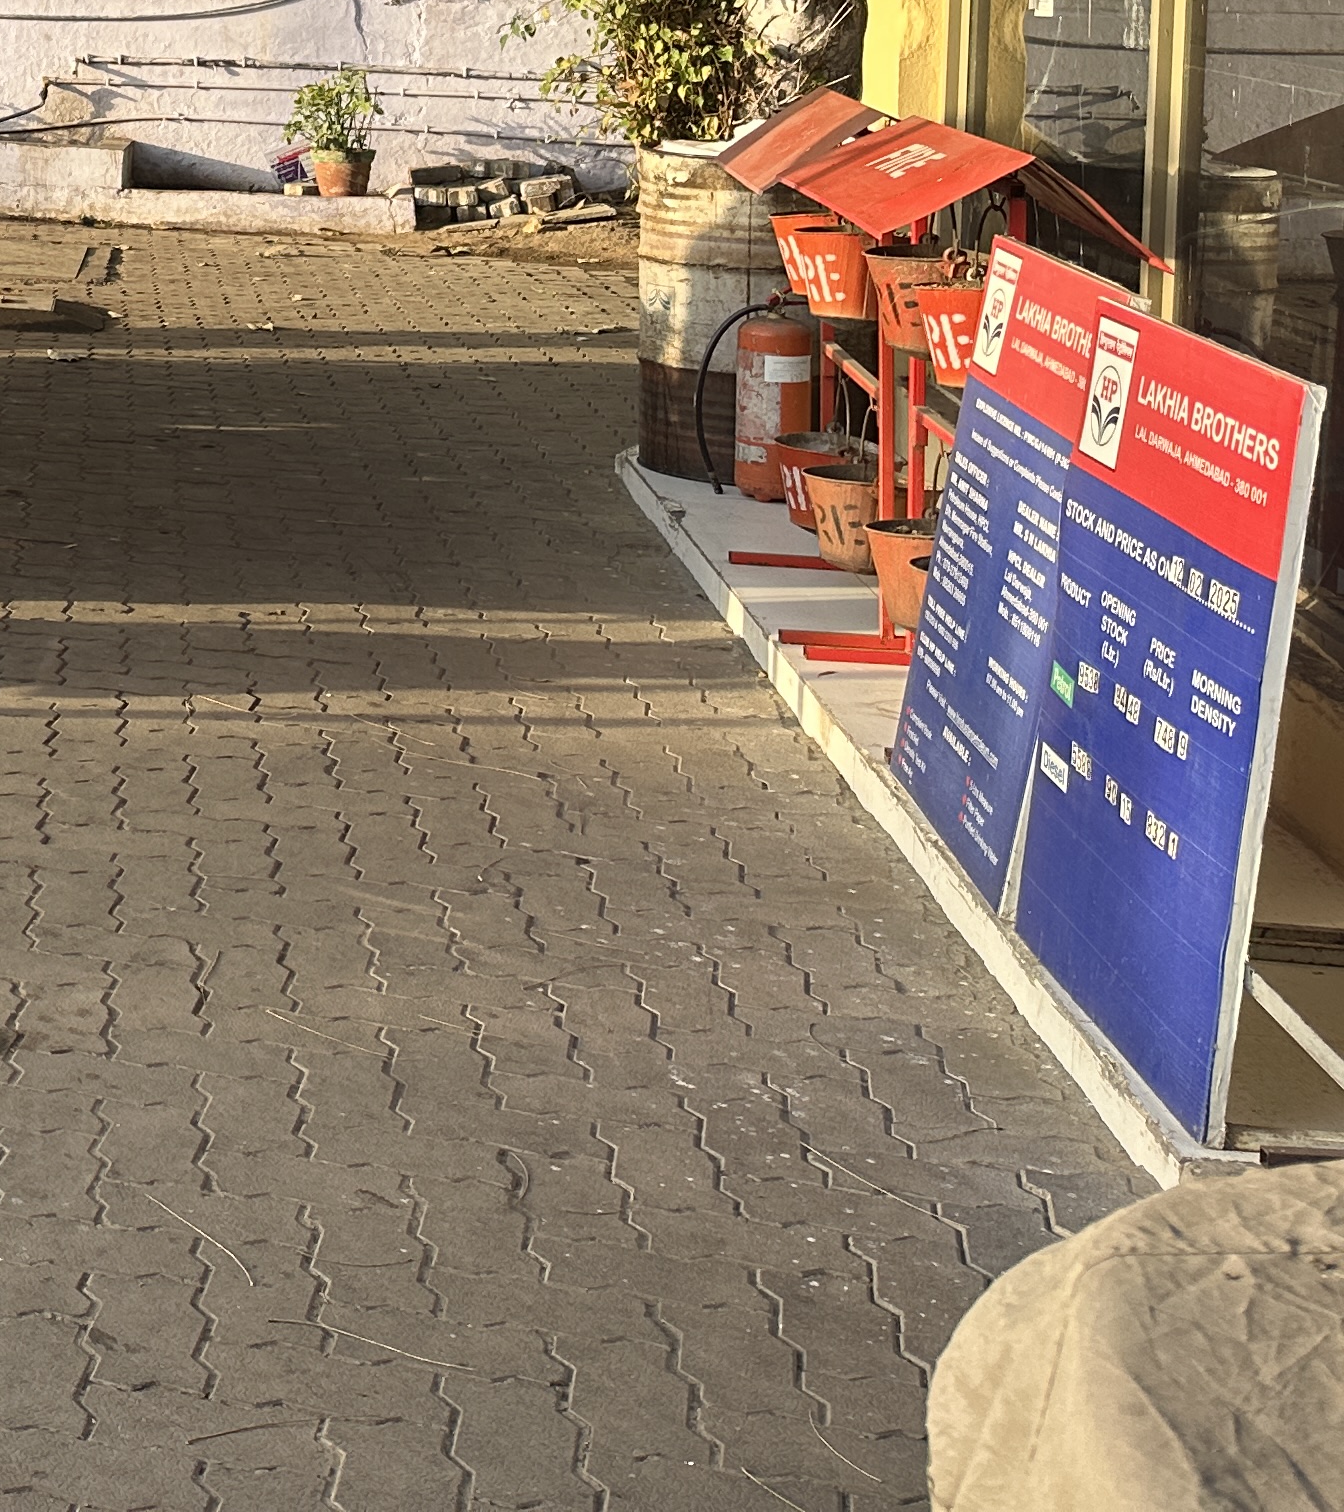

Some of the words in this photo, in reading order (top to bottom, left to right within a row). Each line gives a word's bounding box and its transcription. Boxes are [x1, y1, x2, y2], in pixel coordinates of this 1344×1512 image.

[1016, 297, 1051, 334] LAKHIA
[1100, 375, 1118, 404] HP
[1138, 377, 1188, 424] LAKHIA
[1191, 403, 1279, 469] BROTHERS
[1135, 424, 1147, 442] LAL
[1148, 431, 1182, 463] DARWAJA,
[1184, 451, 1230, 486] AHMEDABAD
[1251, 486, 1267, 506] 001
[1066, 499, 1095, 531] STOCK
[1094, 518, 1115, 543] AND
[1115, 529, 1143, 561] PRICE
[1140, 544, 1157, 570] AS
[1190, 571, 1203, 598] 02
[1210, 582, 1238, 615] 2025
[1061, 573, 1091, 607] PRODUCT
[1101, 591, 1136, 626] OPENING
[1101, 615, 1128, 646] STOCK
[1150, 638, 1176, 668] PRICE
[1052, 667, 1073, 705] Petrol
[1192, 670, 1241, 714] MORNING
[1191, 695, 1236, 736] DENSITY
[1043, 750, 1066, 785] Diesel
[1122, 797, 1131, 821] 15
